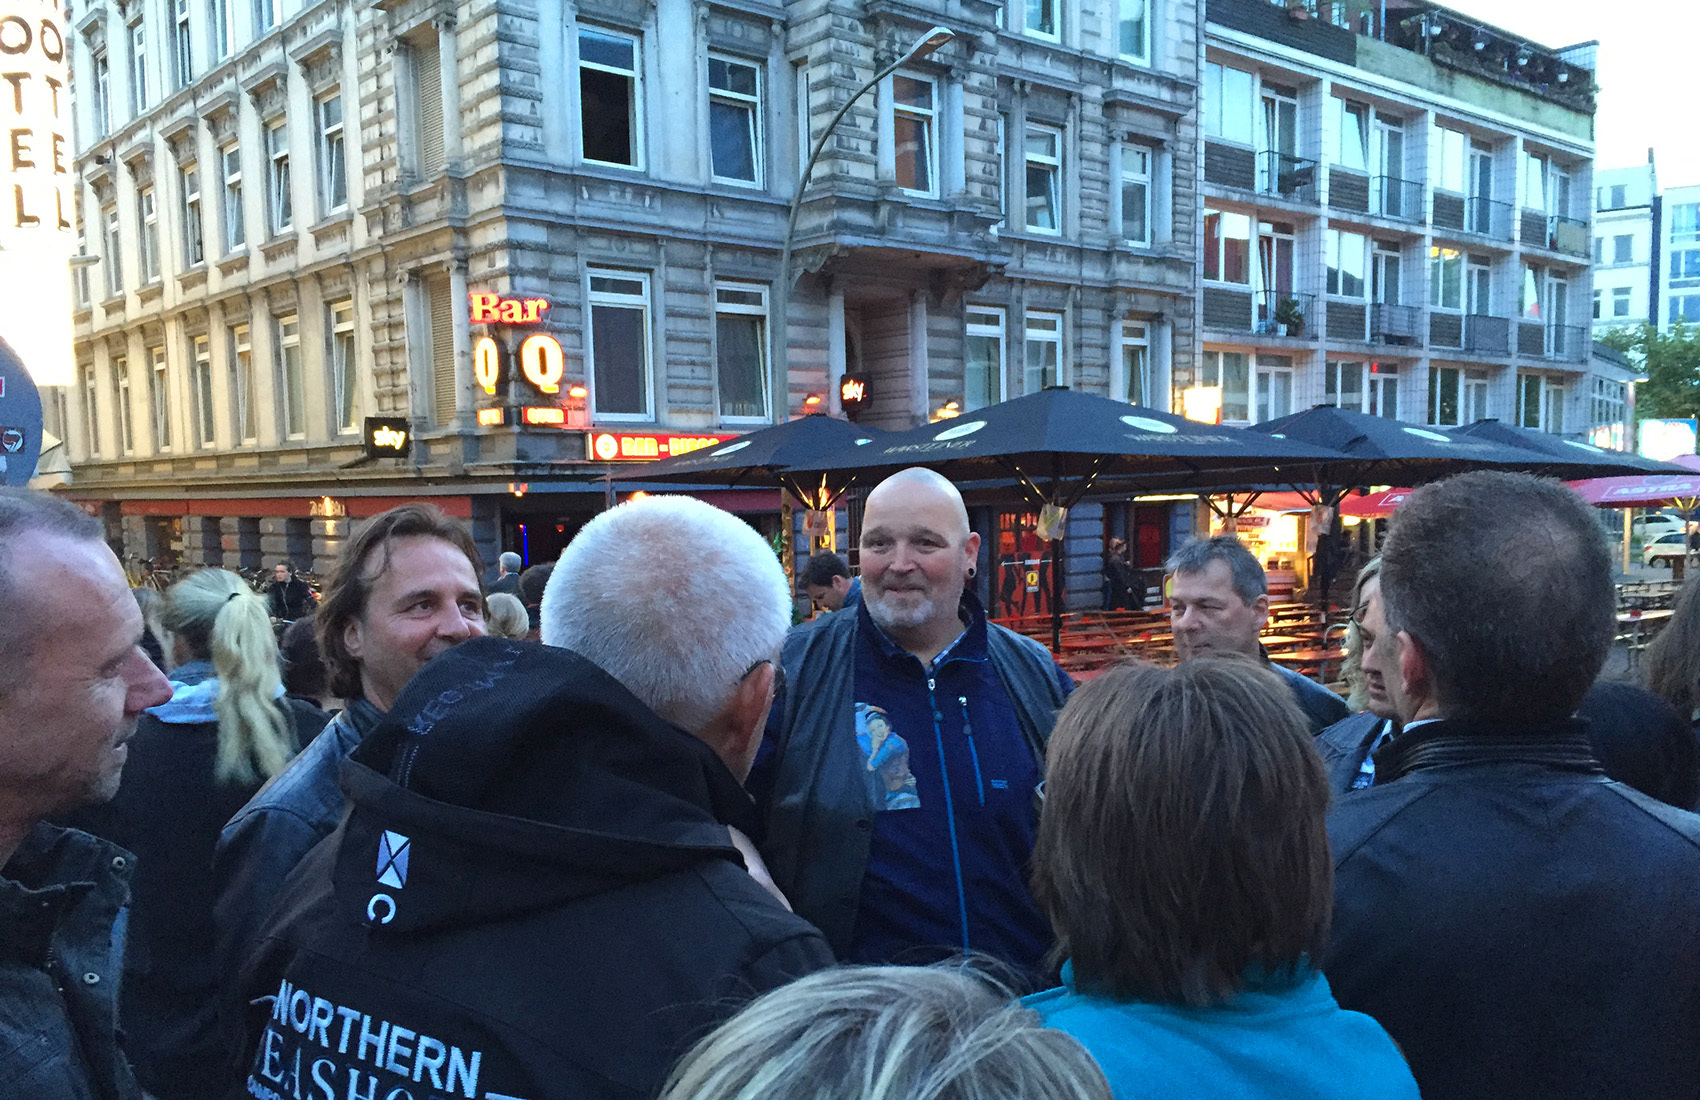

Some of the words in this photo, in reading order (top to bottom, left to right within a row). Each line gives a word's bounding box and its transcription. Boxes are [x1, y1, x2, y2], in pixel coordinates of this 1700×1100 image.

[468, 292, 549, 324] Bar
[475, 336, 498, 395] Q
[521, 334, 565, 394] Q
[842, 380, 864, 402] sky
[373, 425, 406, 450] sky
[1026, 572, 1038, 586] Q
[272, 978, 482, 1099] NORTHERN
